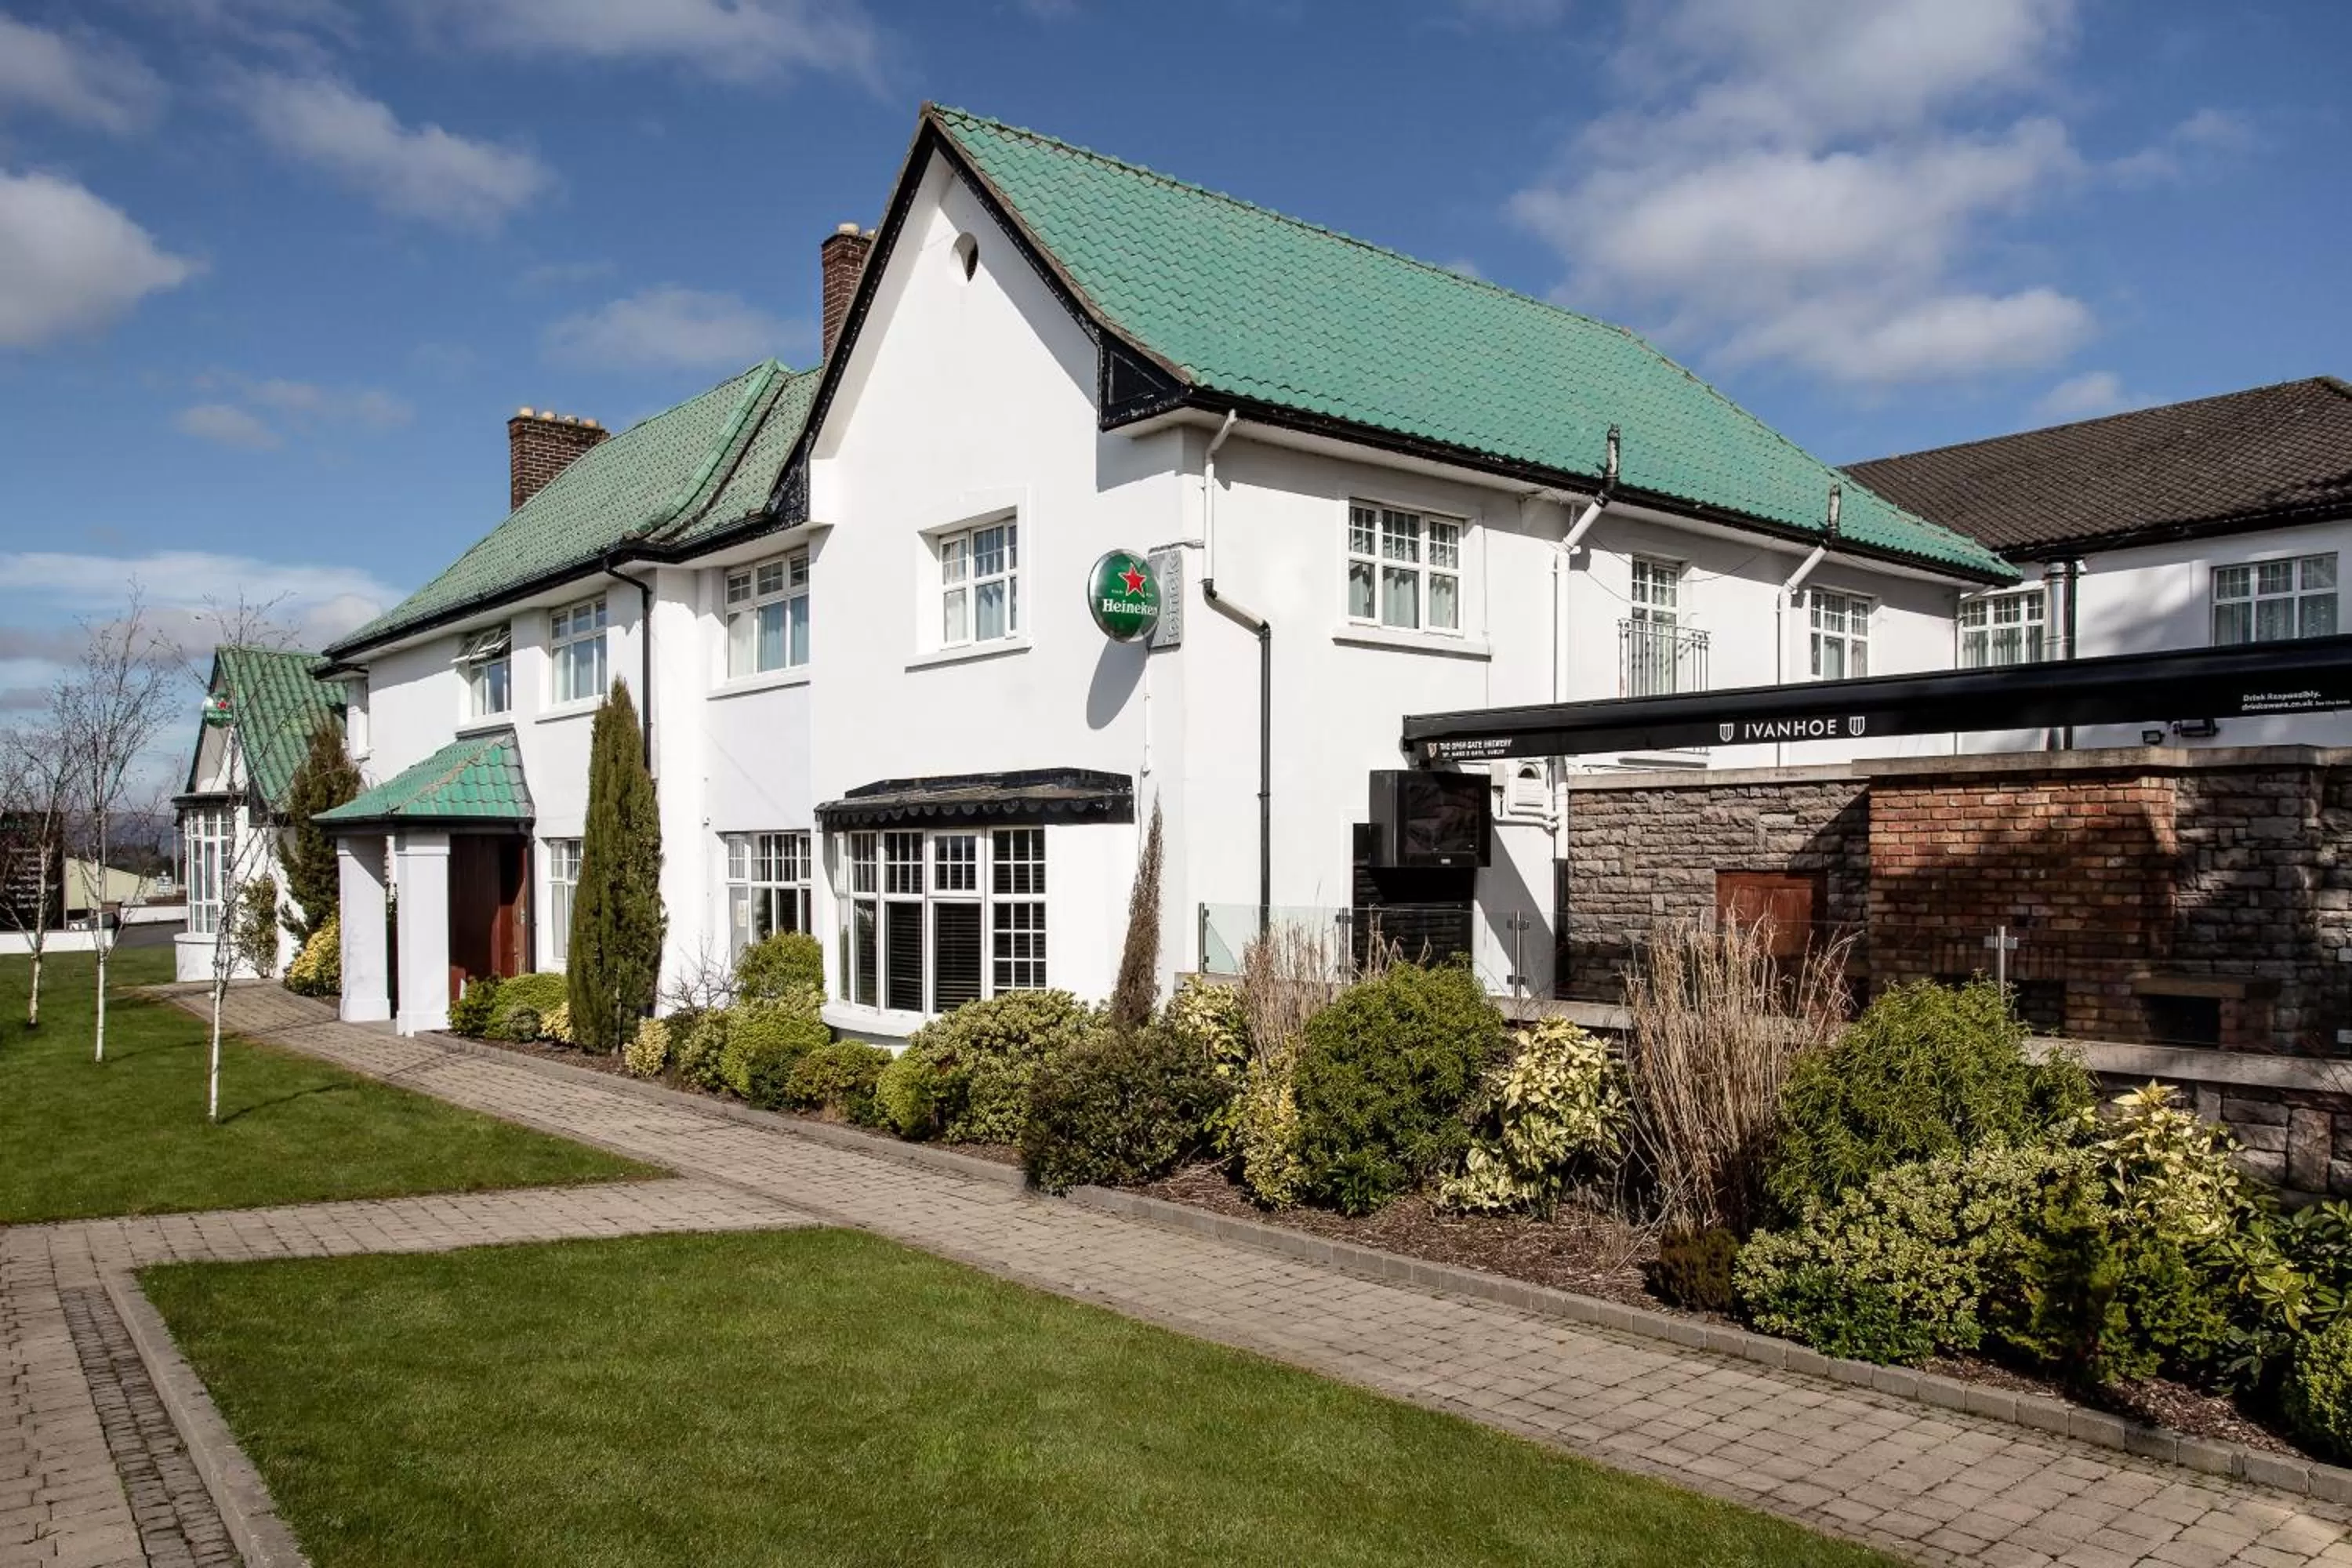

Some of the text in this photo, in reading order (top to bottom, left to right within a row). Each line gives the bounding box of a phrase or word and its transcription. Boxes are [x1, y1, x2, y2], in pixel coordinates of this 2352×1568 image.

[1102, 598, 1158, 615] Heineken
[1745, 719, 1837, 739] IVANHOE
[1468, 740, 1483, 749] GATE
